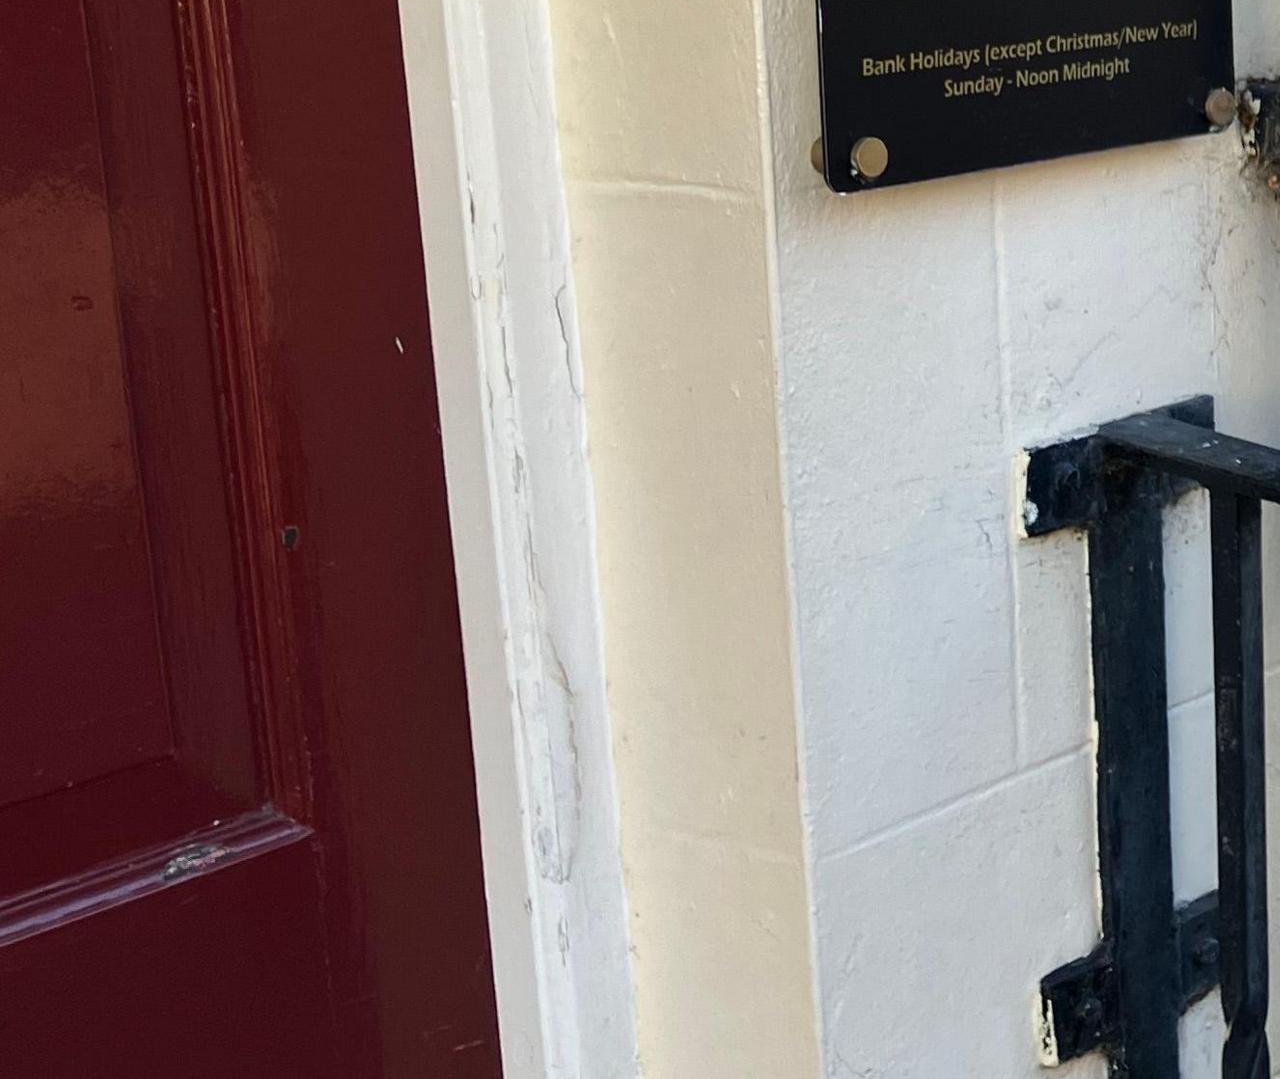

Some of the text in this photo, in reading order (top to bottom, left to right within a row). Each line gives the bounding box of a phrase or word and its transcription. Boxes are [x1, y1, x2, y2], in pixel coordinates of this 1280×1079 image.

[864, 56, 905, 75] Bank
[911, 49, 979, 70] Holidays
[986, 40, 1041, 65] (except
[1162, 21, 1196, 38] Year)
[945, 76, 1003, 96] Sunday
[1017, 70, 1058, 87] Noon
[1064, 58, 1129, 80] Midnight
